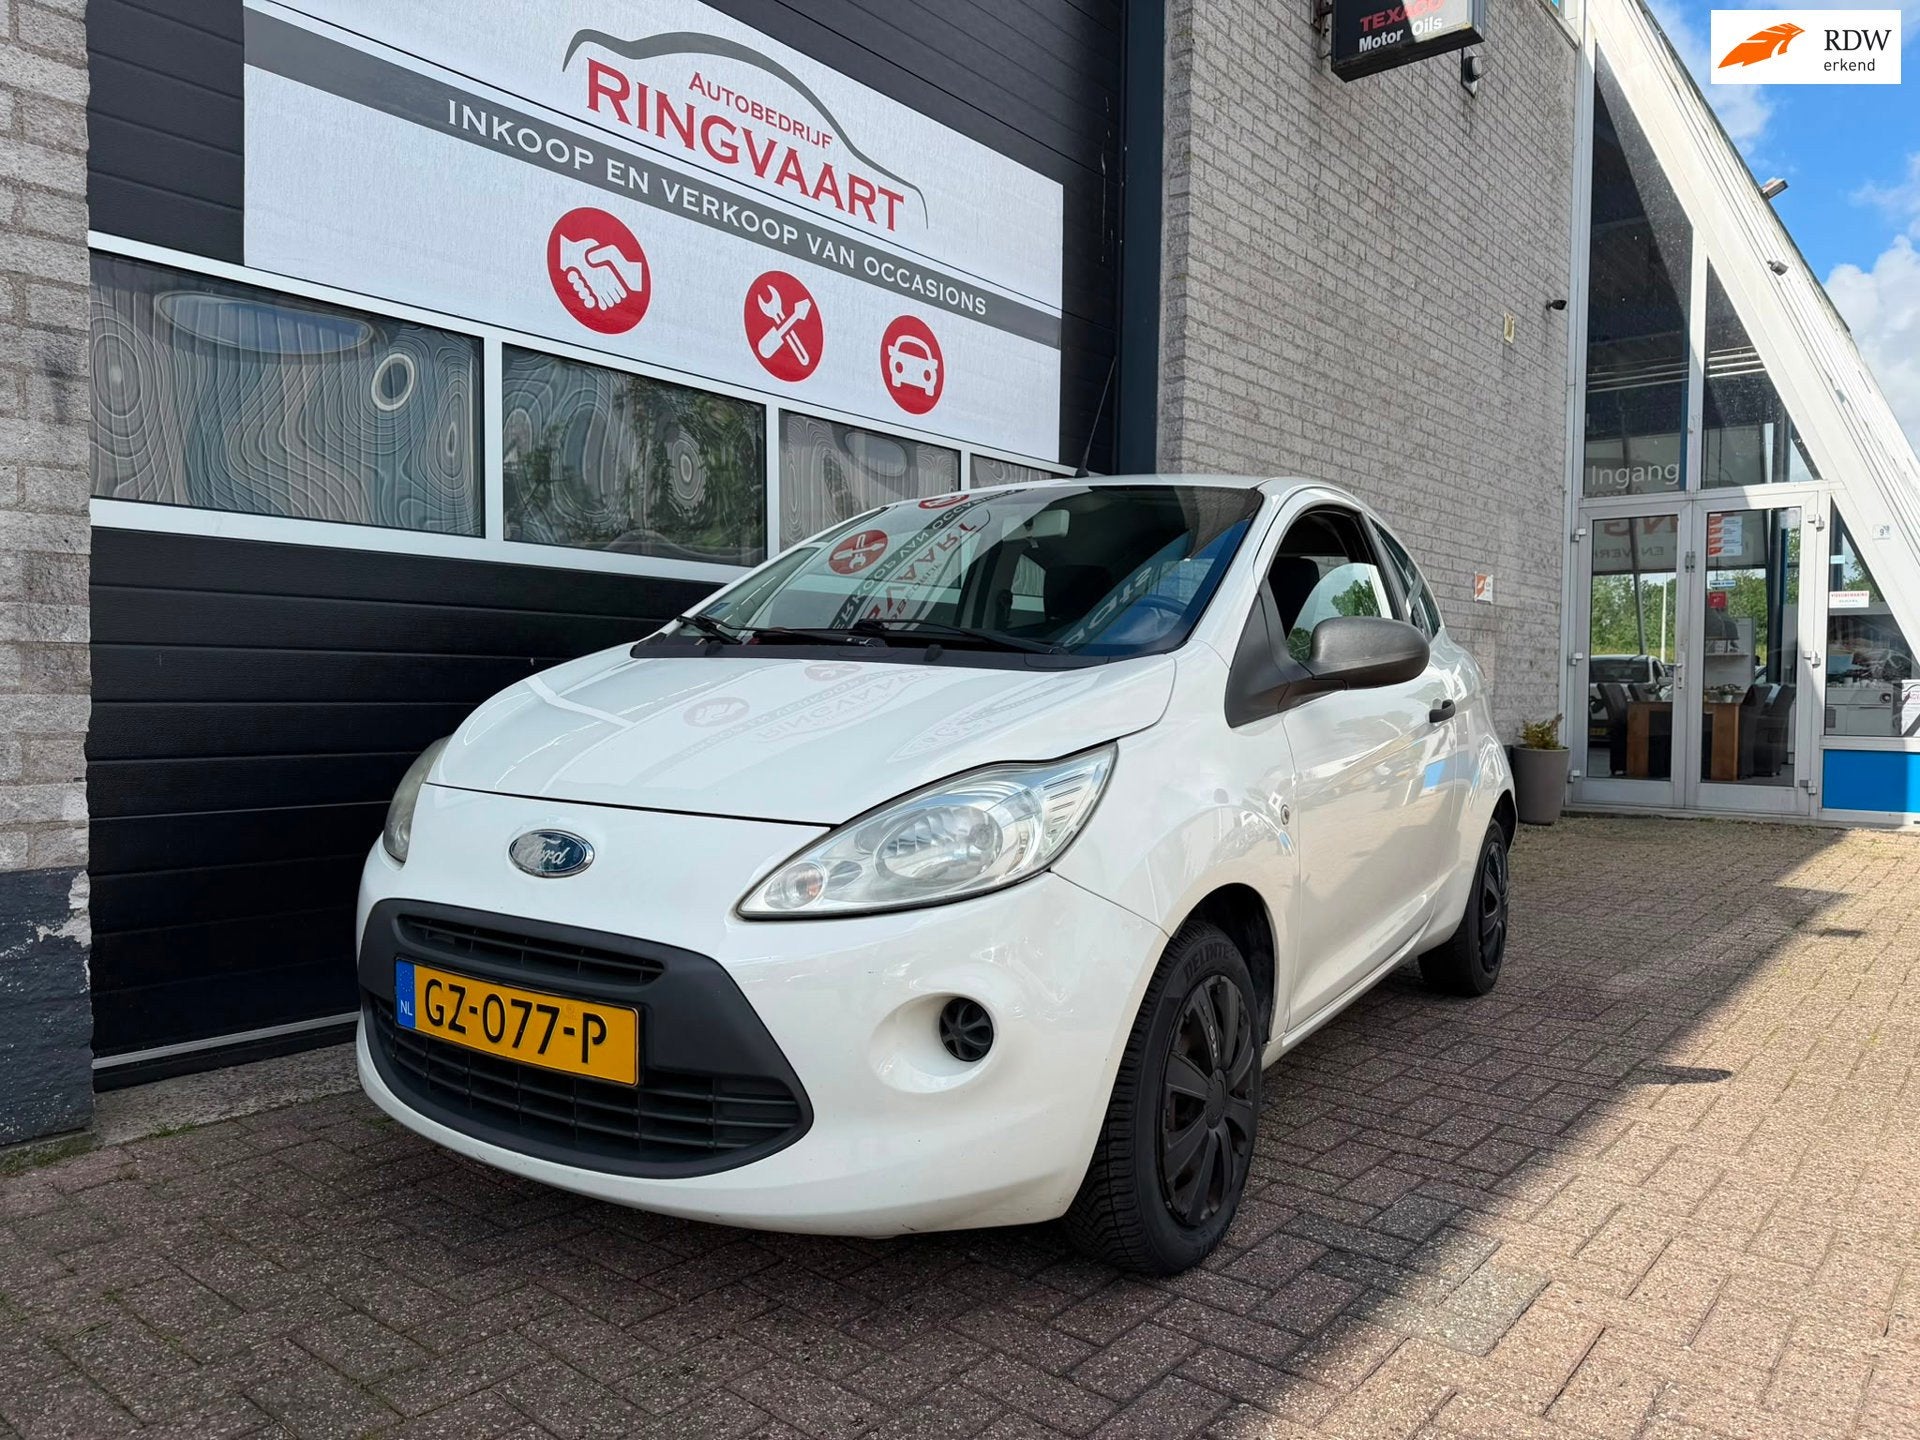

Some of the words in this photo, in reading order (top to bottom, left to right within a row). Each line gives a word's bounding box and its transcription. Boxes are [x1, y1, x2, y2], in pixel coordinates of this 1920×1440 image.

[1358, 28, 1404, 53] Motor
[1411, 15, 1443, 37] Oils
[586, 56, 905, 232] RINGVAART
[688, 70, 833, 149] AUTOBEDRIJF
[448, 99, 594, 171] INKOOP
[606, 158, 649, 195] EN
[660, 178, 799, 245] VERKOOP
[806, 232, 856, 270] VAN
[863, 256, 987, 316] OCCASIONS
[1591, 463, 1680, 490] Ingang
[400, 1000, 413, 1016] NL
[424, 978, 608, 1065] GZ-077-P
